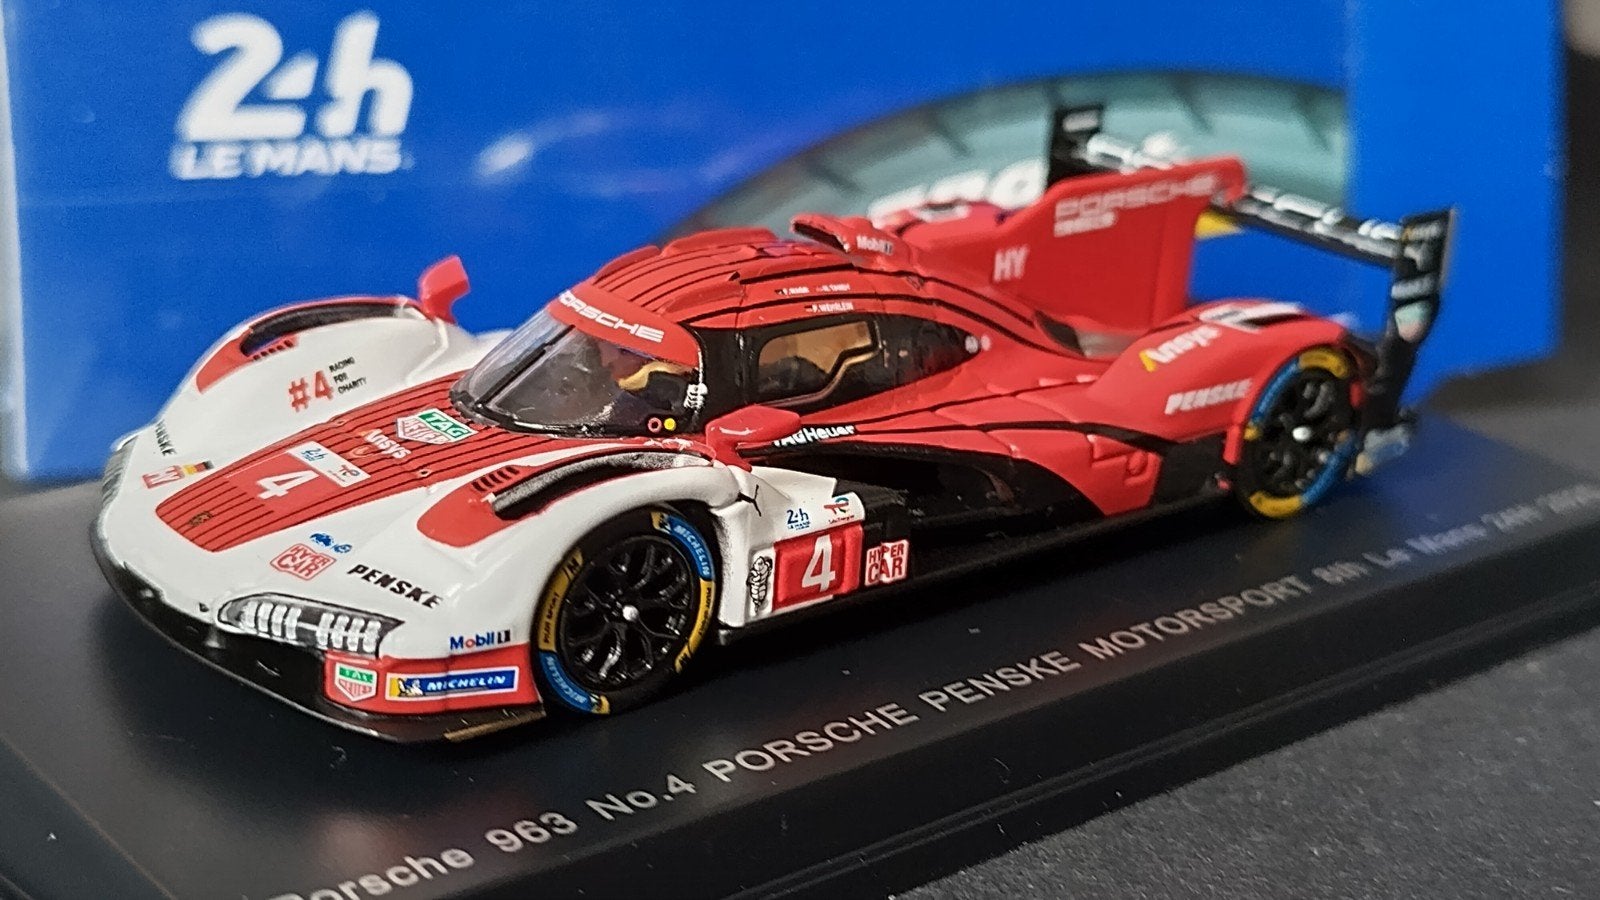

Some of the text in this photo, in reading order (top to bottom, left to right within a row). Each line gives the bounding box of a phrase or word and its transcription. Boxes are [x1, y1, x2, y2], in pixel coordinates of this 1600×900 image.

[171, 136, 400, 180] LE MANS
[1055, 174, 1217, 218] PORSCHE
[994, 243, 1029, 282] HY
[559, 290, 664, 342] ORSCHE
[328, 356, 355, 372] RACING
[333, 372, 348, 384] FOR
[288, 370, 334, 412] #4
[337, 376, 367, 394] CHARITY
[1164, 378, 1252, 415] PENSKE
[422, 410, 472, 438] TAG
[255, 470, 320, 499] 4
[276, 553, 320, 577] CAR
[673, 524, 711, 576] MICHELIN
[801, 533, 836, 592] 4
[869, 543, 904, 564] HYPER
[346, 563, 443, 609] PENSKE
[867, 557, 903, 583] CAR
[449, 631, 495, 650] Mobil
[426, 675, 507, 692] MICHELIN
[546, 656, 588, 704] MICHELIN
[485, 812, 579, 852] 963
[585, 775, 696, 820] No.4
[702, 702, 920, 782] PORSCHE
[918, 650, 1081, 712] PENSKE
[1078, 575, 1312, 660] MOTORSPORT
[1361, 549, 1411, 569] Le
